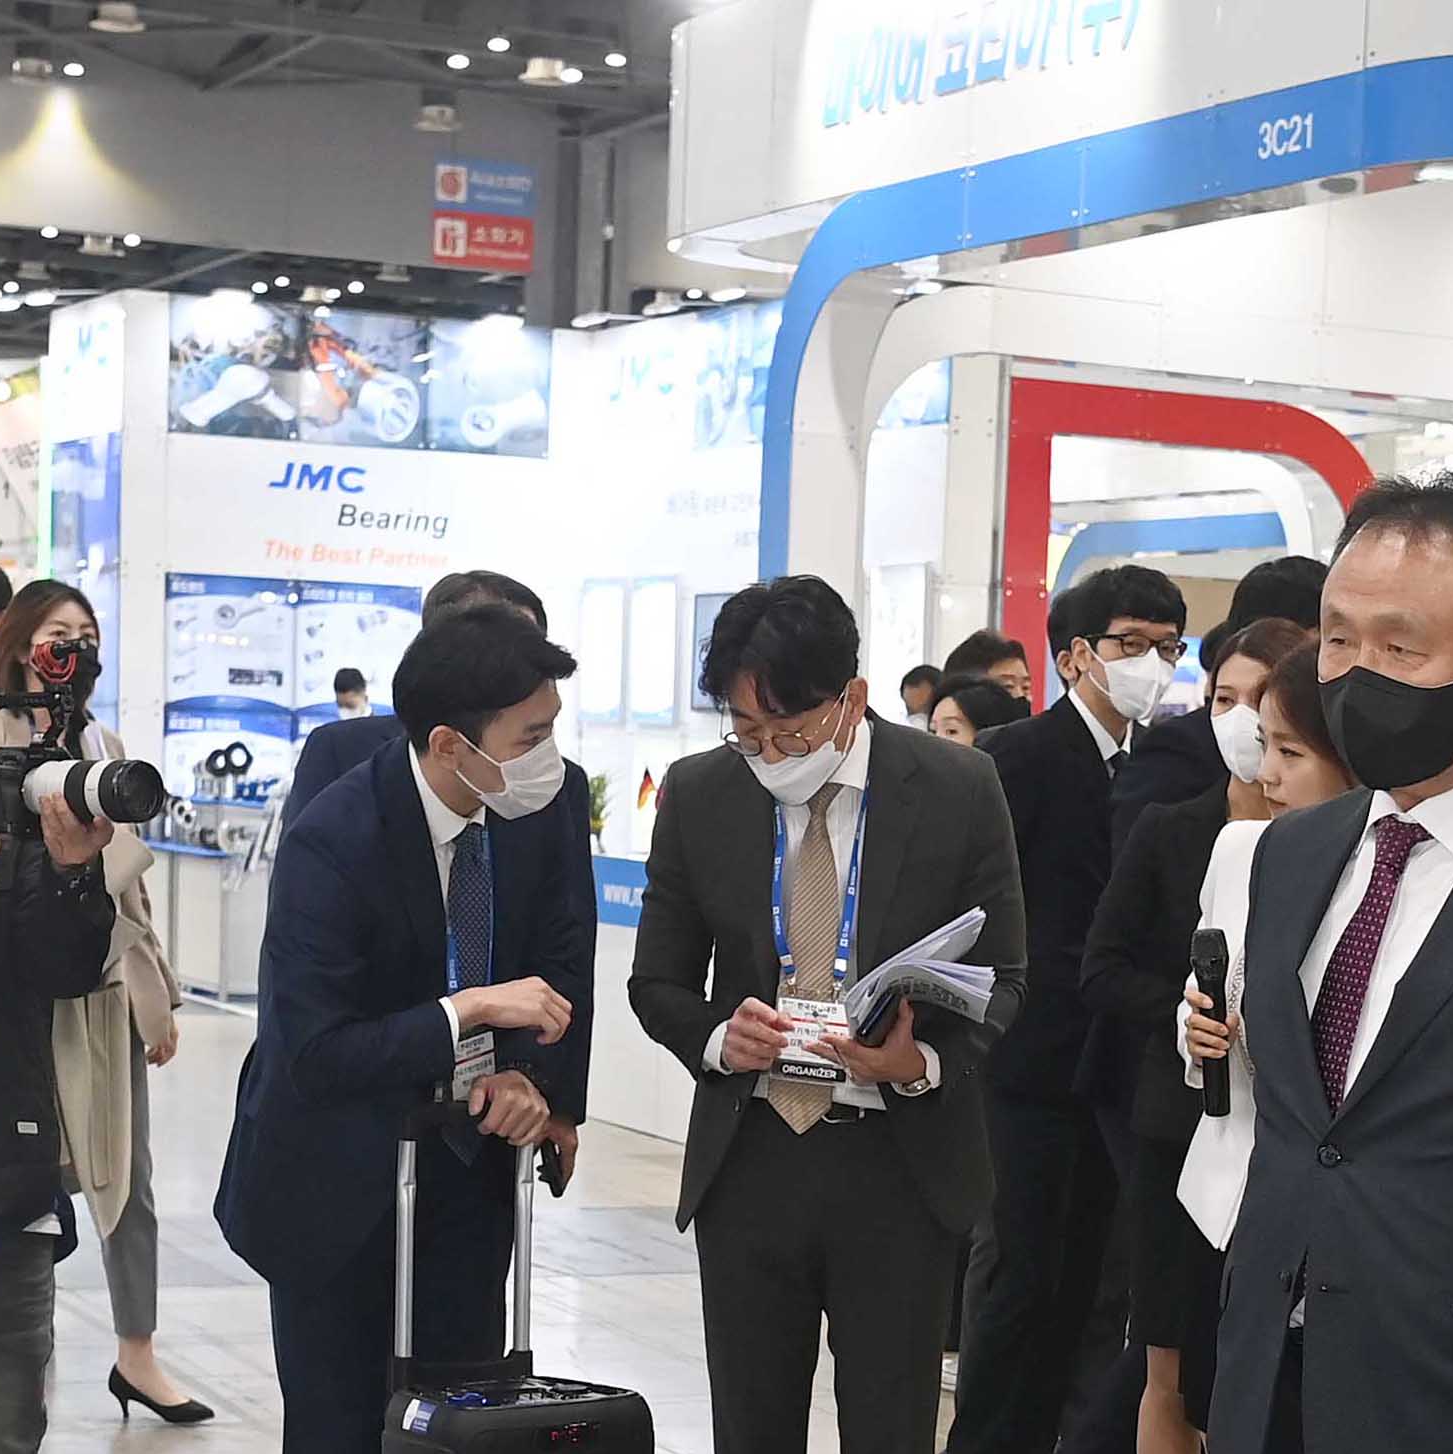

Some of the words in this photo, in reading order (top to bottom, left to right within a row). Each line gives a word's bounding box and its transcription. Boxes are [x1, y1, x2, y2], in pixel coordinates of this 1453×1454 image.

[1257, 112, 1314, 160] 3C21
[268, 462, 367, 494] JMC
[337, 503, 449, 540] Bearing
[781, 1063, 838, 1080] ORGANIZER
